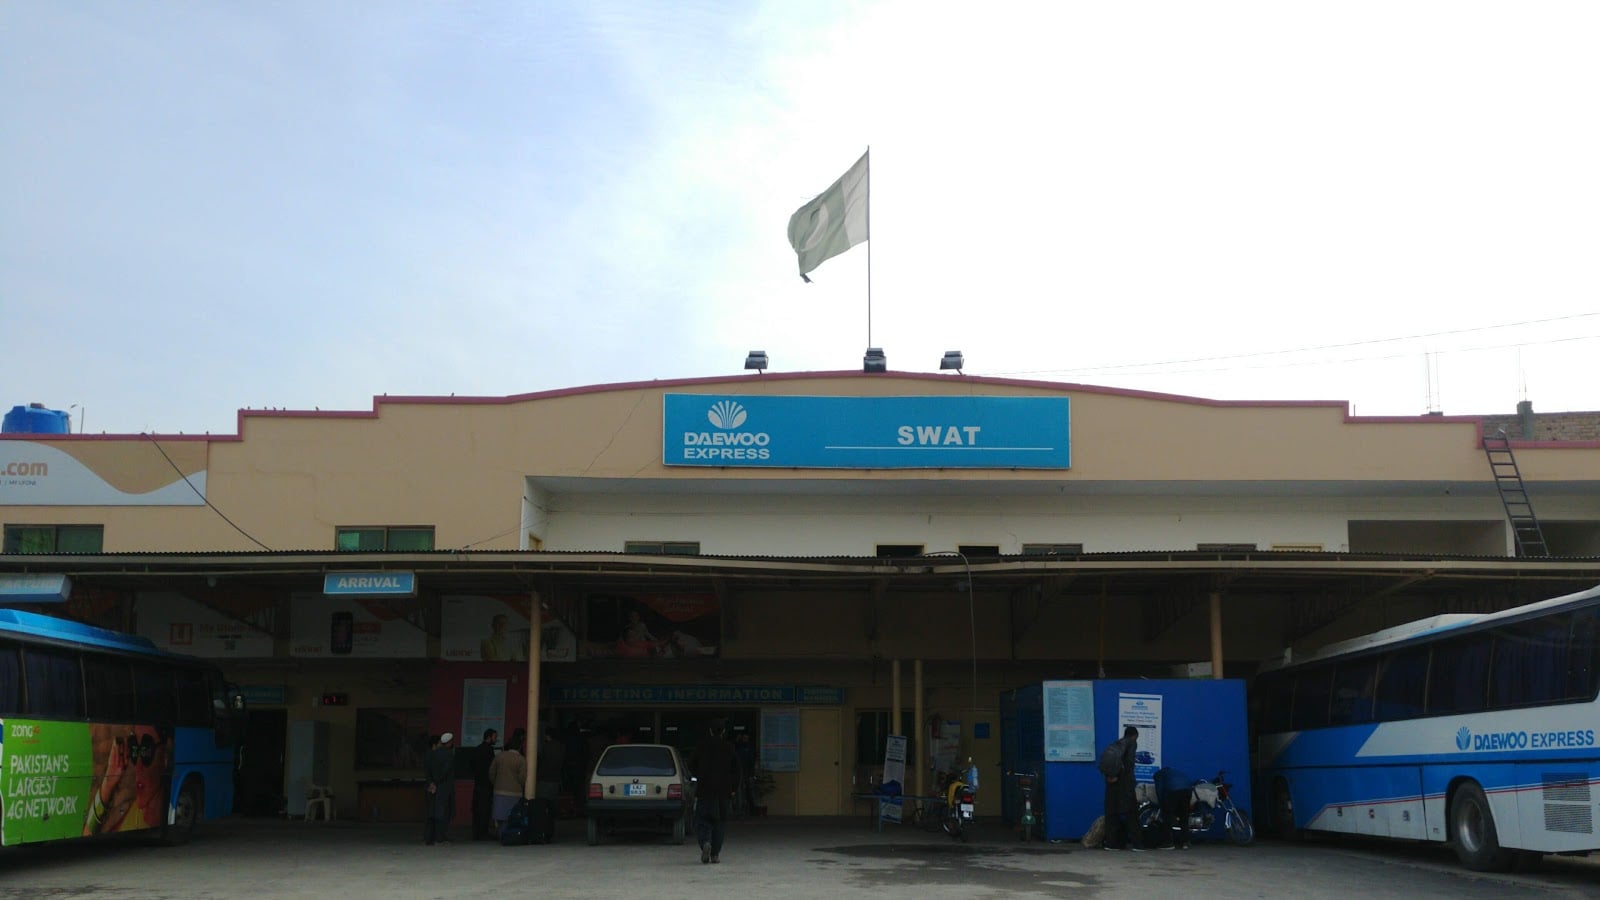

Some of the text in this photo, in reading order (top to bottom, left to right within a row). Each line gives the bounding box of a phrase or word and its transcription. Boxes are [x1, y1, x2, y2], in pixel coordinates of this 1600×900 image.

[684, 432, 770, 446] DAEWOO
[897, 426, 981, 446] SWAT
[684, 448, 770, 459] EXPRESS
[1, 463, 48, 476] .com
[337, 577, 400, 588] ARRIVAL
[562, 688, 652, 699] TICKETING
[667, 688, 783, 699] INFORMATION
[1474, 730, 1594, 750] DAEWOO EXPRESS
[10, 754, 69, 774] PAKISTAN'S
[8, 776, 58, 797] LARGEST
[7, 796, 78, 819] 4G NETWORK
